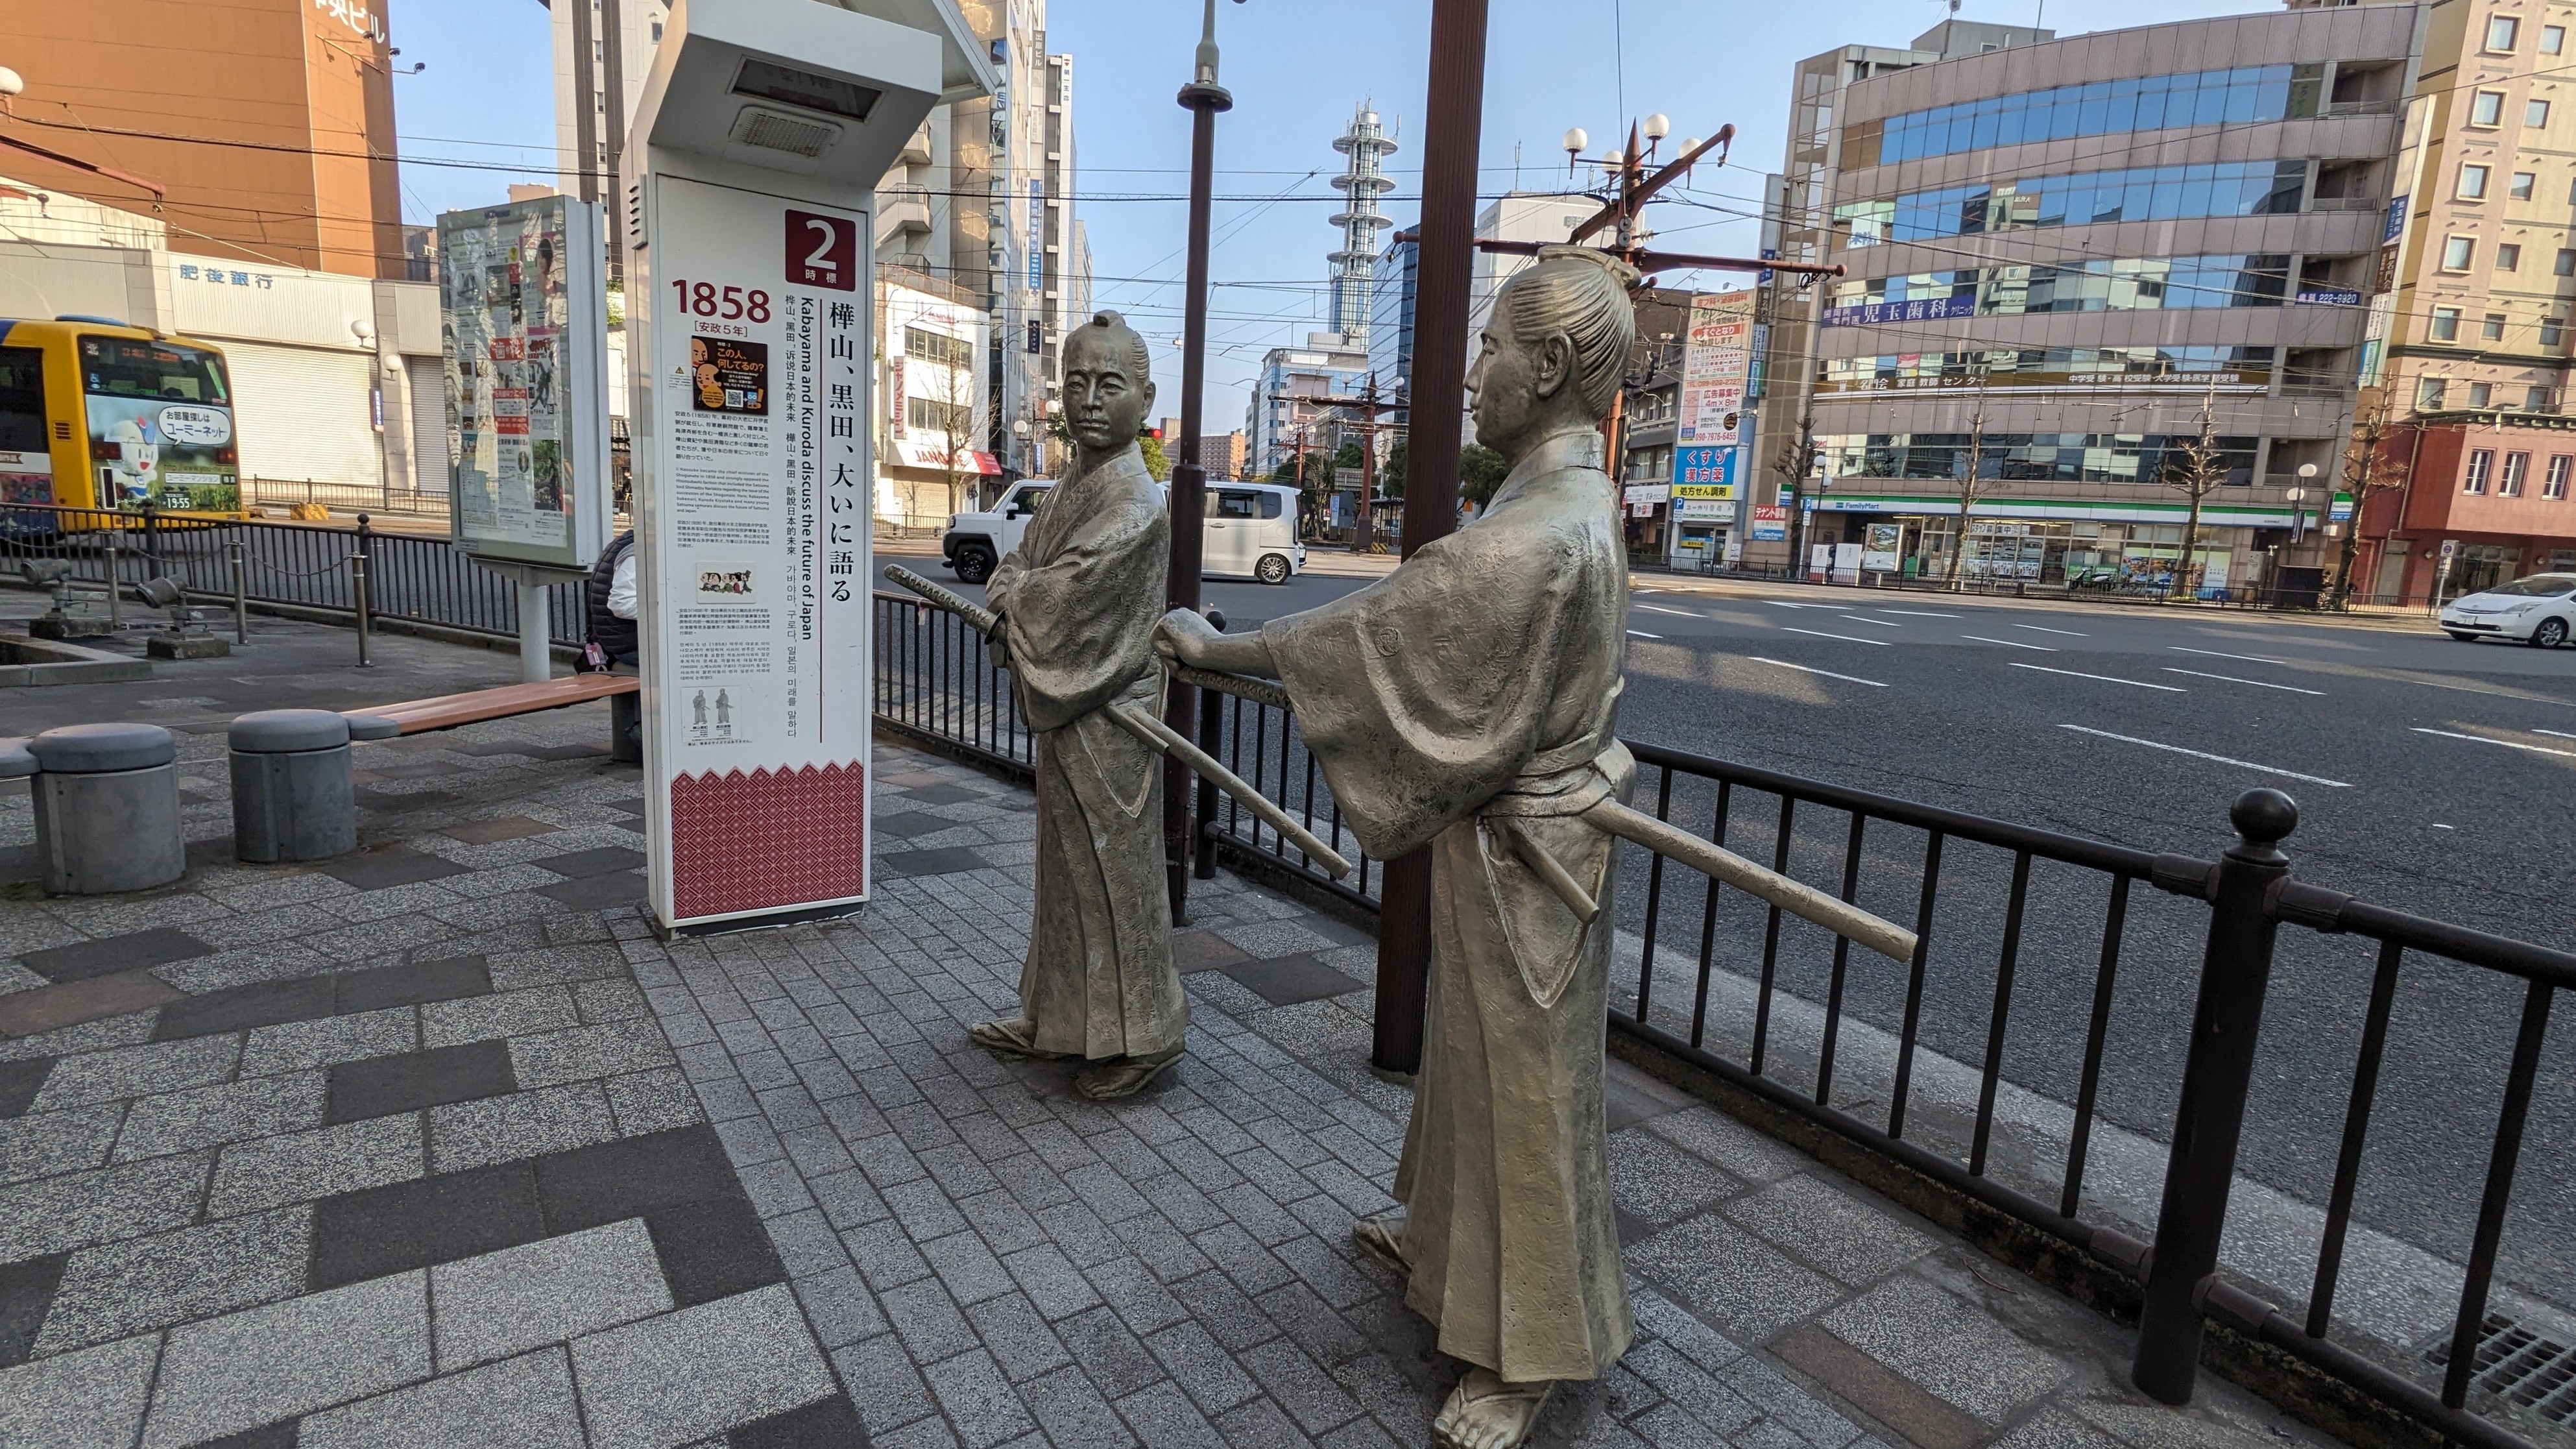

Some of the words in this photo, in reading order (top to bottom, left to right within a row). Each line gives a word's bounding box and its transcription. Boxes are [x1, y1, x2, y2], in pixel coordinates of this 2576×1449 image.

[315, 0, 385, 43] 央ビル
[804, 219, 837, 270] 2
[180, 264, 273, 289] 肥後銀行
[804, 269, 837, 284] 時標
[672, 279, 771, 323] 1858
[1863, 298, 1947, 324] 児玉歯科
[1950, 306, 1973, 316] クリニック
[798, 297, 814, 372] Kabayama
[717, 348, 747, 359] この人、
[717, 359, 764, 372] 何してるの?
[801, 375, 815, 403] and
[1703, 388, 1740, 399] 広告募集中
[1860, 378, 1888, 390] 名門会
[1897, 376, 1987, 388] 家庭教師センター
[895, 361, 904, 434] ジャノメミシン
[166, 411, 210, 422] お部屋探しは
[167, 423, 227, 437] ユーミーネット
[801, 407, 815, 457] Kuroda
[1695, 432, 1737, 441] 090-7976-6455
[828, 301, 855, 602] 樺山、黒田、大いに語る
[1687, 450, 1727, 465] くすり
[167, 474, 219, 484] ユーミーマンション
[802, 461, 815, 510] discuss
[1685, 467, 1725, 483] 漢方薬
[1680, 487, 1727, 496] 処方せん調剤
[1676, 498, 1683, 508] P
[1755, 507, 1786, 518] テナント募集
[1806, 498, 1811, 509] P
[802, 515, 815, 536] the
[802, 541, 815, 581] future
[802, 585, 815, 599] of
[799, 602, 814, 640] Japan
[787, 646, 797, 675] 일본의
[787, 679, 797, 707] 미래를
[787, 711, 797, 738] 말하다
